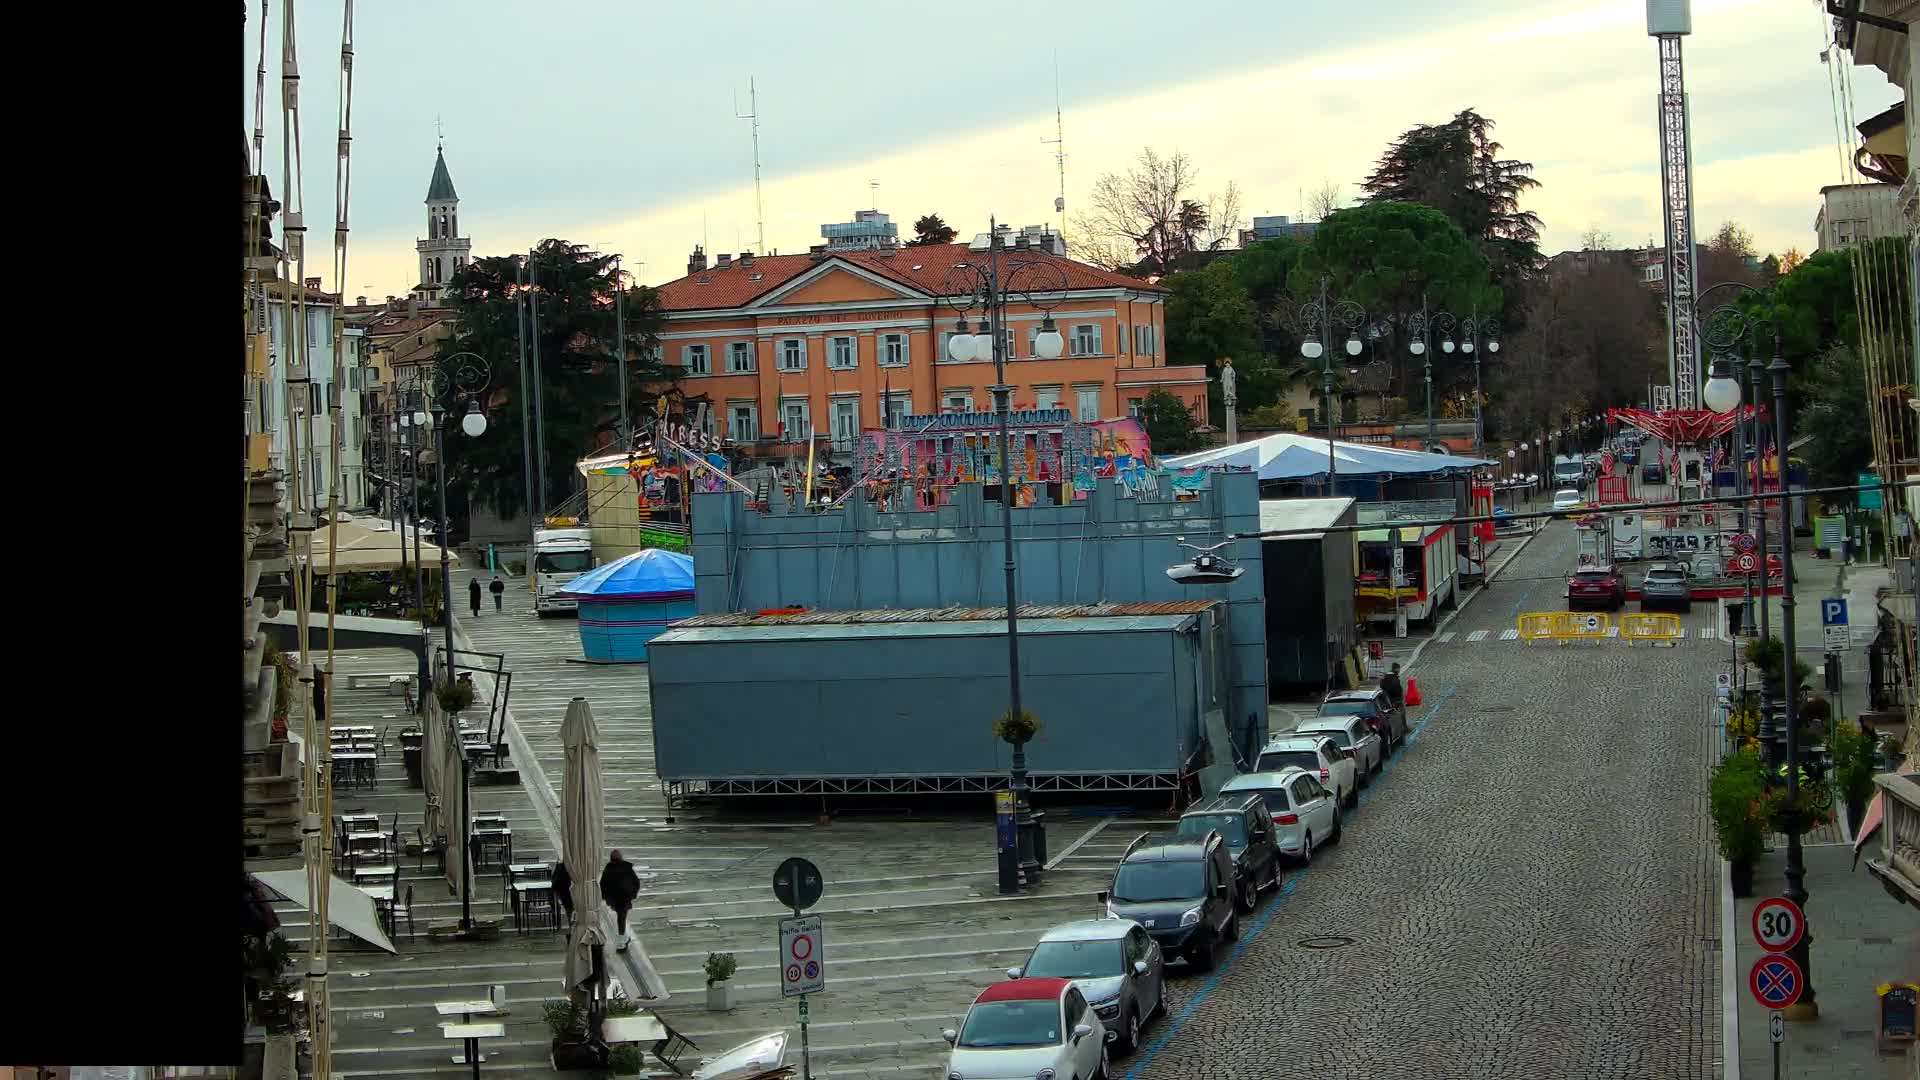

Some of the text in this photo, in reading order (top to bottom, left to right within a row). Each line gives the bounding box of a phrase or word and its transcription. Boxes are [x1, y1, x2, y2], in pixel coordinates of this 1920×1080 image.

[1742, 557, 1752, 568] 20
[1827, 602, 1842, 622] P
[1762, 911, 1792, 938] 30
